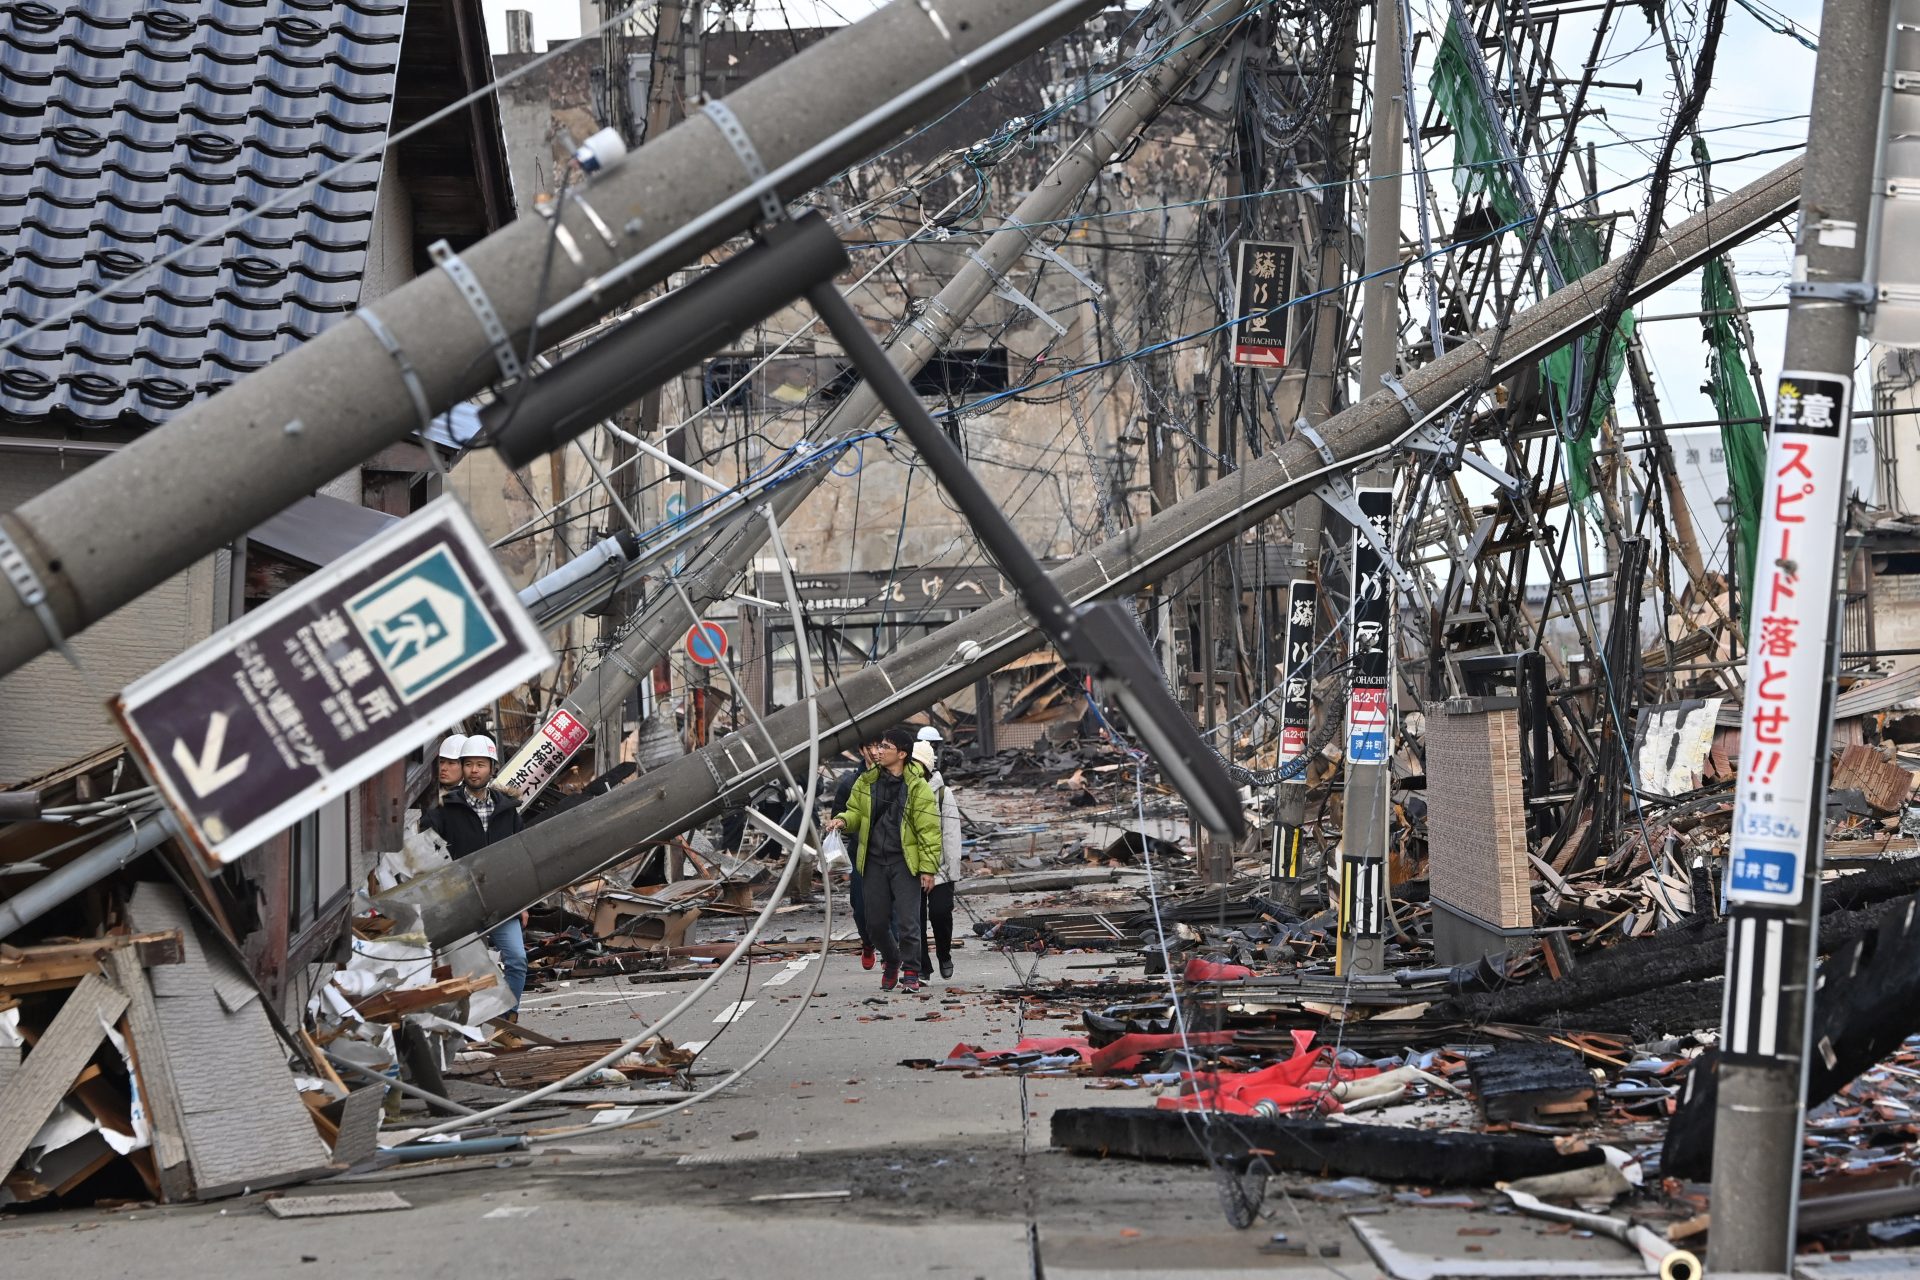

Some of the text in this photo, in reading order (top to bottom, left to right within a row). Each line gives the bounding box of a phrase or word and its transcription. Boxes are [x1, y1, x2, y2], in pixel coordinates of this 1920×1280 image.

[1241, 336, 1282, 346] TOHACHIYA
[296, 626, 370, 734] Evacuation Shelter
[309, 609, 399, 725] 避難所
[543, 724, 574, 754] 朝市通り
[553, 713, 584, 743] 無料
